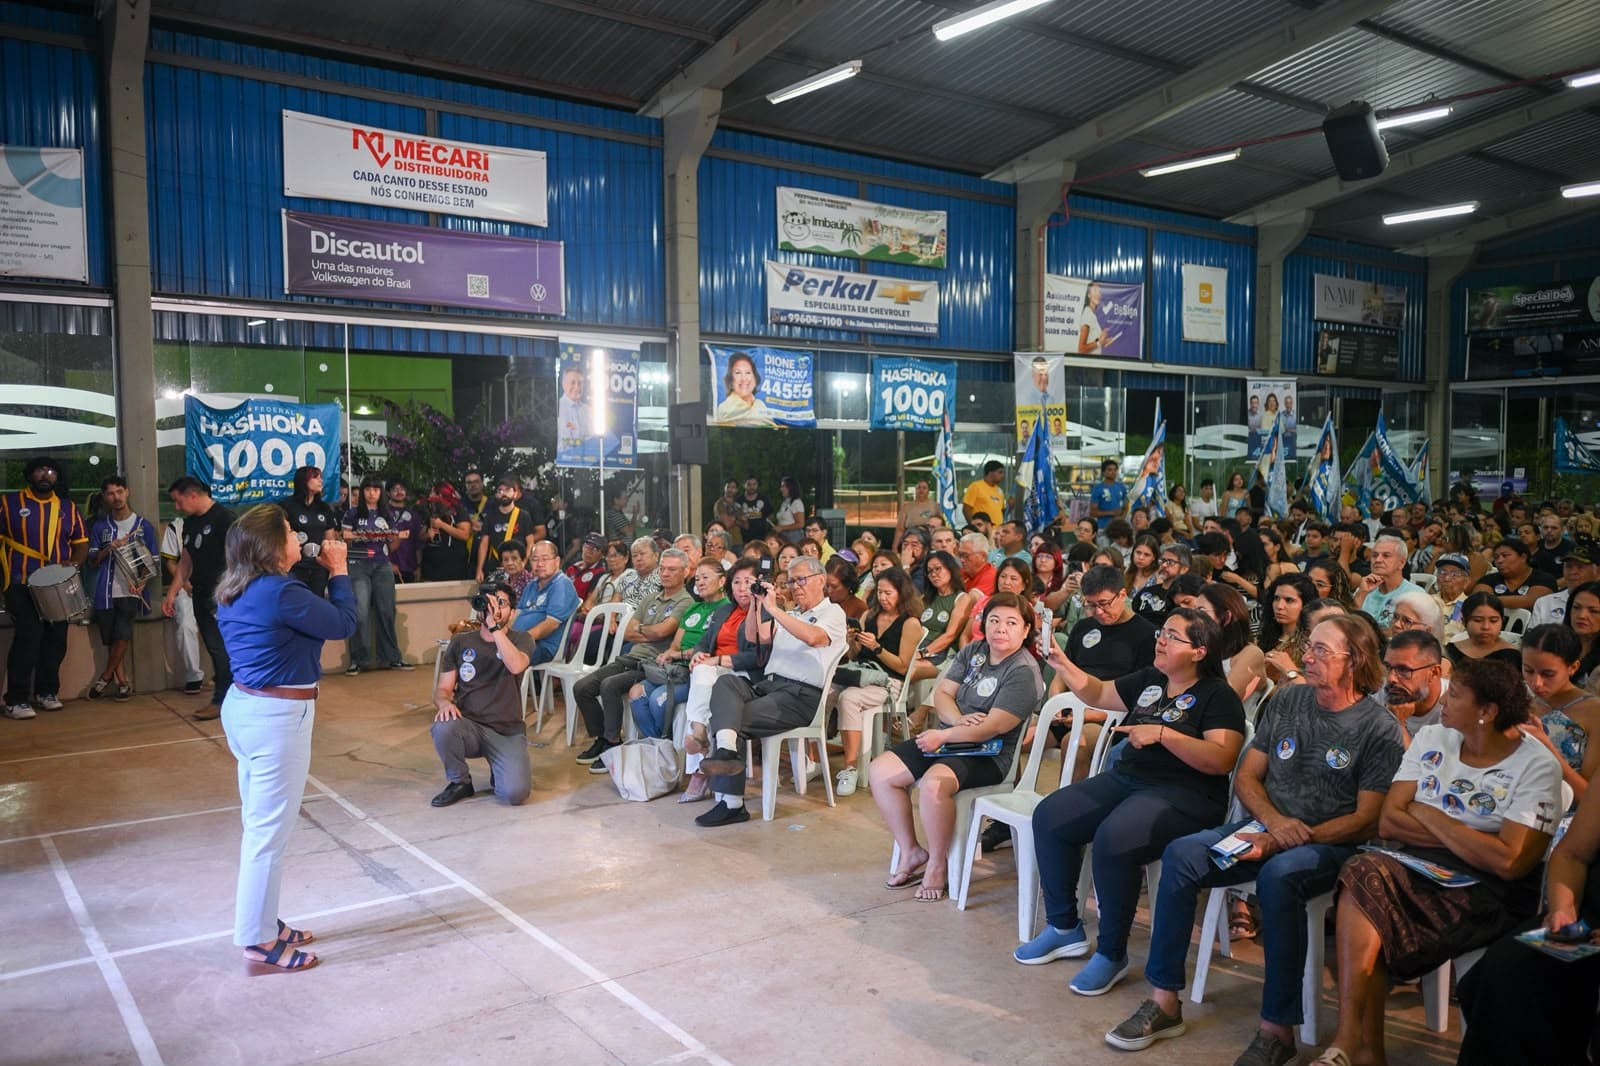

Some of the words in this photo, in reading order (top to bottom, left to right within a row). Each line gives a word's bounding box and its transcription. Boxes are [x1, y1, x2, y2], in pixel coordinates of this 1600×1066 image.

[394, 160, 489, 183] DISTRIBUIDORA
[353, 170, 381, 184] CADA
[383, 173, 416, 188] CANTO
[418, 178, 449, 192] DESSE
[452, 182, 488, 198] ESTADO
[370, 184, 392, 199] NÓS
[452, 196, 474, 209] BEM
[310, 230, 424, 265] Discautol
[311, 259, 335, 271] Uma
[337, 261, 354, 273] das
[356, 264, 394, 276] maiores
[311, 271, 370, 289] Volkswagen
[371, 275, 385, 288] do
[386, 277, 411, 290] Brasil
[782, 269, 878, 301] Perkal
[804, 300, 856, 314] ESPECIALISTA
[857, 304, 869, 314] EM
[870, 305, 910, 317] CHEVROLET
[1065, 316, 1074, 324] de
[764, 354, 795, 369] DIONE
[881, 368, 947, 386] HASHIOKA
[761, 379, 813, 400] 44555
[255, 406, 295, 415] FEDERAL
[881, 385, 945, 416] 1000
[200, 413, 325, 437] HASHIOKA
[205, 438, 326, 480] 1000
[211, 482, 234, 493] POR
[259, 479, 286, 488] PELO
